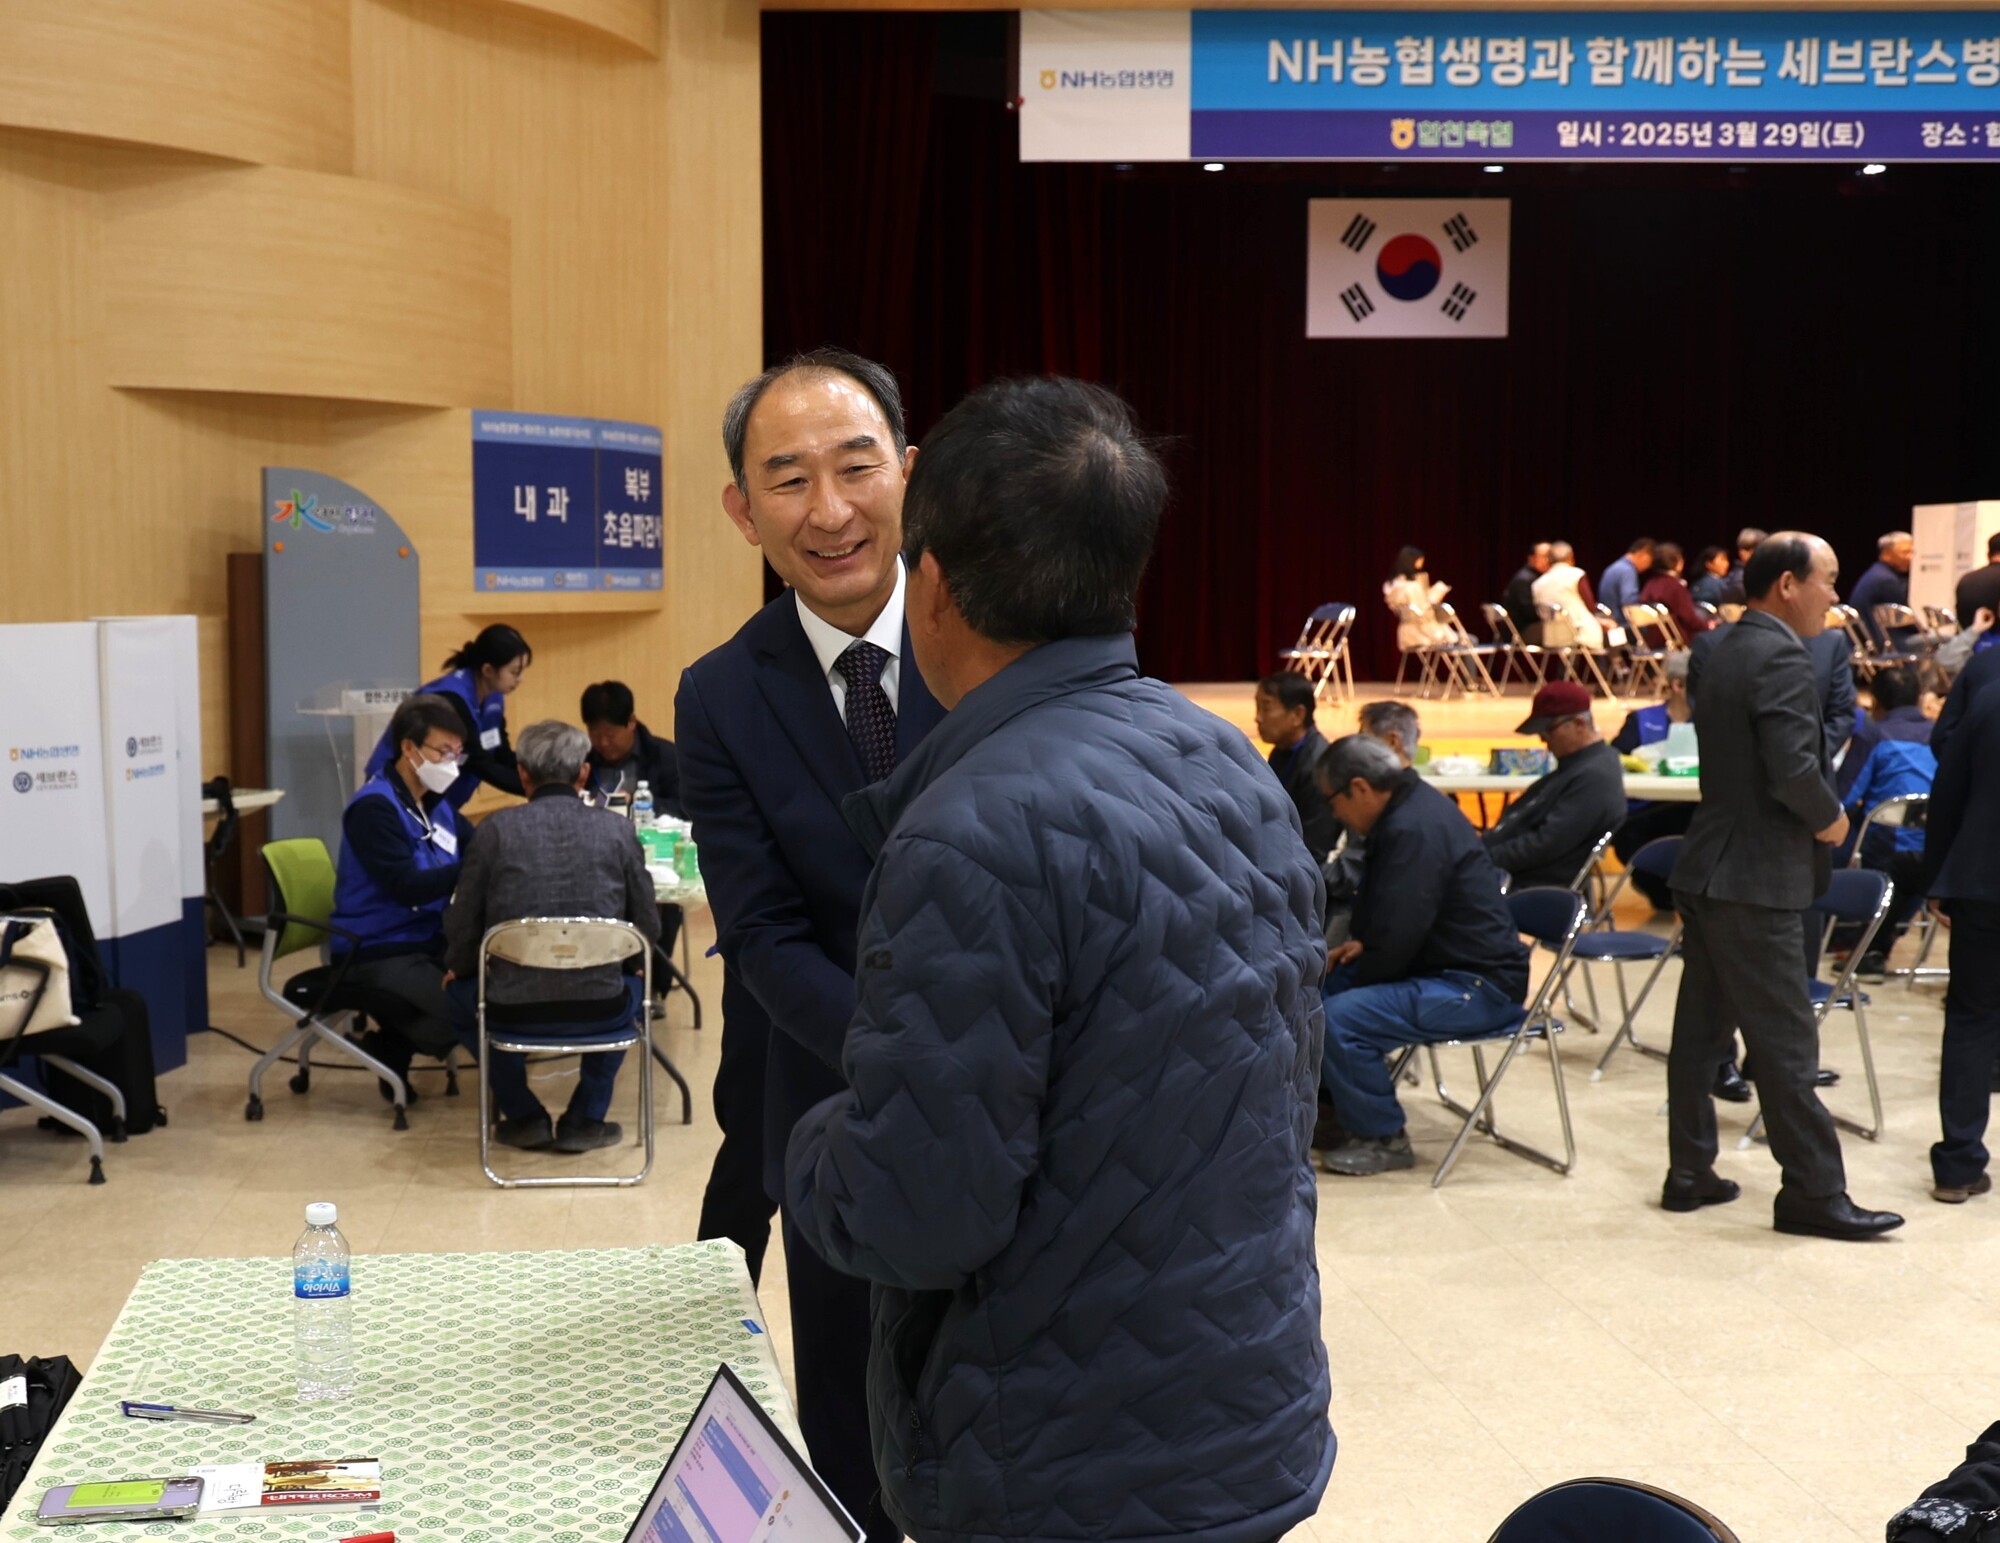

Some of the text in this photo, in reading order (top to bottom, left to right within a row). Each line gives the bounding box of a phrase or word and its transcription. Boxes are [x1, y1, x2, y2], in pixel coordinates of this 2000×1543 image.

[1267, 36, 2000, 87] NH농협생명과 함께하는 세브란스병
[1620, 121, 1713, 147] 2025년
[1718, 121, 1757, 147] 3월
[1763, 120, 1865, 148] 29일(토)
[625, 466, 650, 502] 복부
